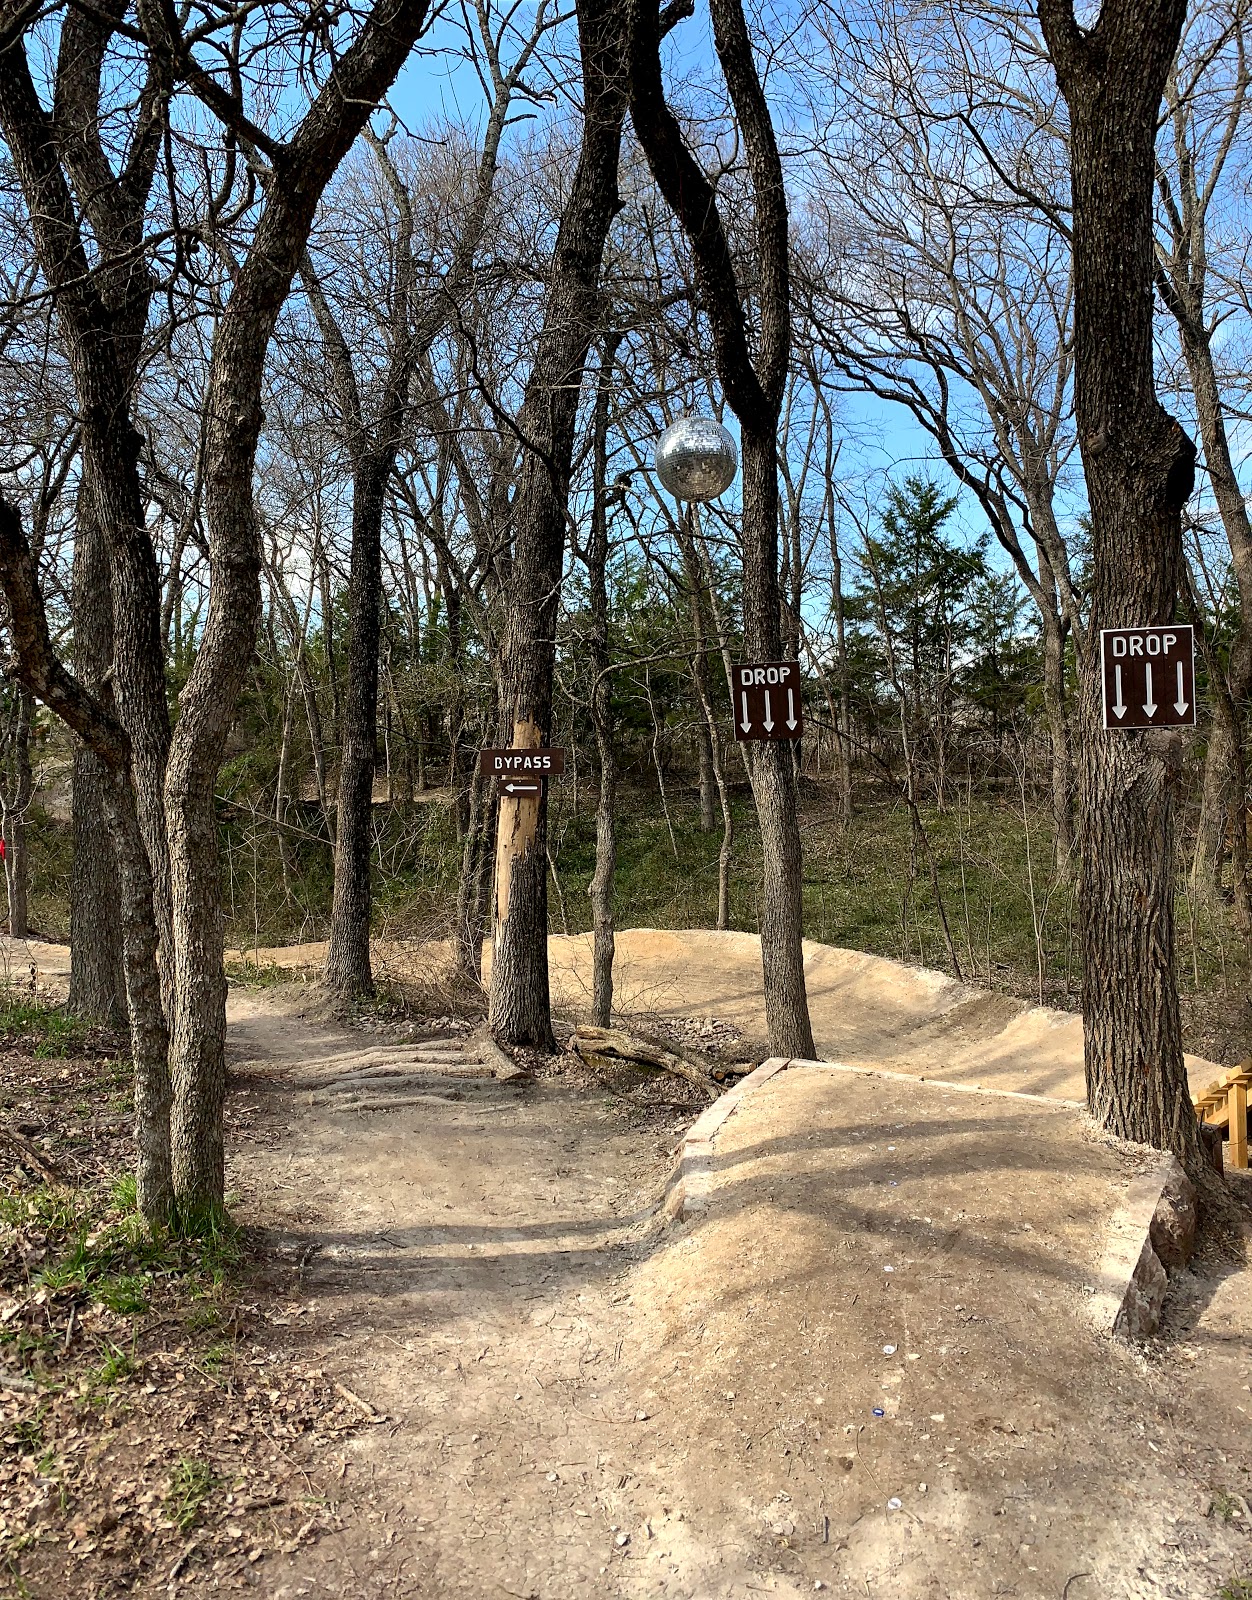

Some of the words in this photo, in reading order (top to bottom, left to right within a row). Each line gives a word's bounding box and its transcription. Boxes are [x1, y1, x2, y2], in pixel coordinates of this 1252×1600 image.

[1112, 634, 1177, 656] DROP
[741, 667, 791, 686] DROP
[494, 756, 551, 769] BYPASS
